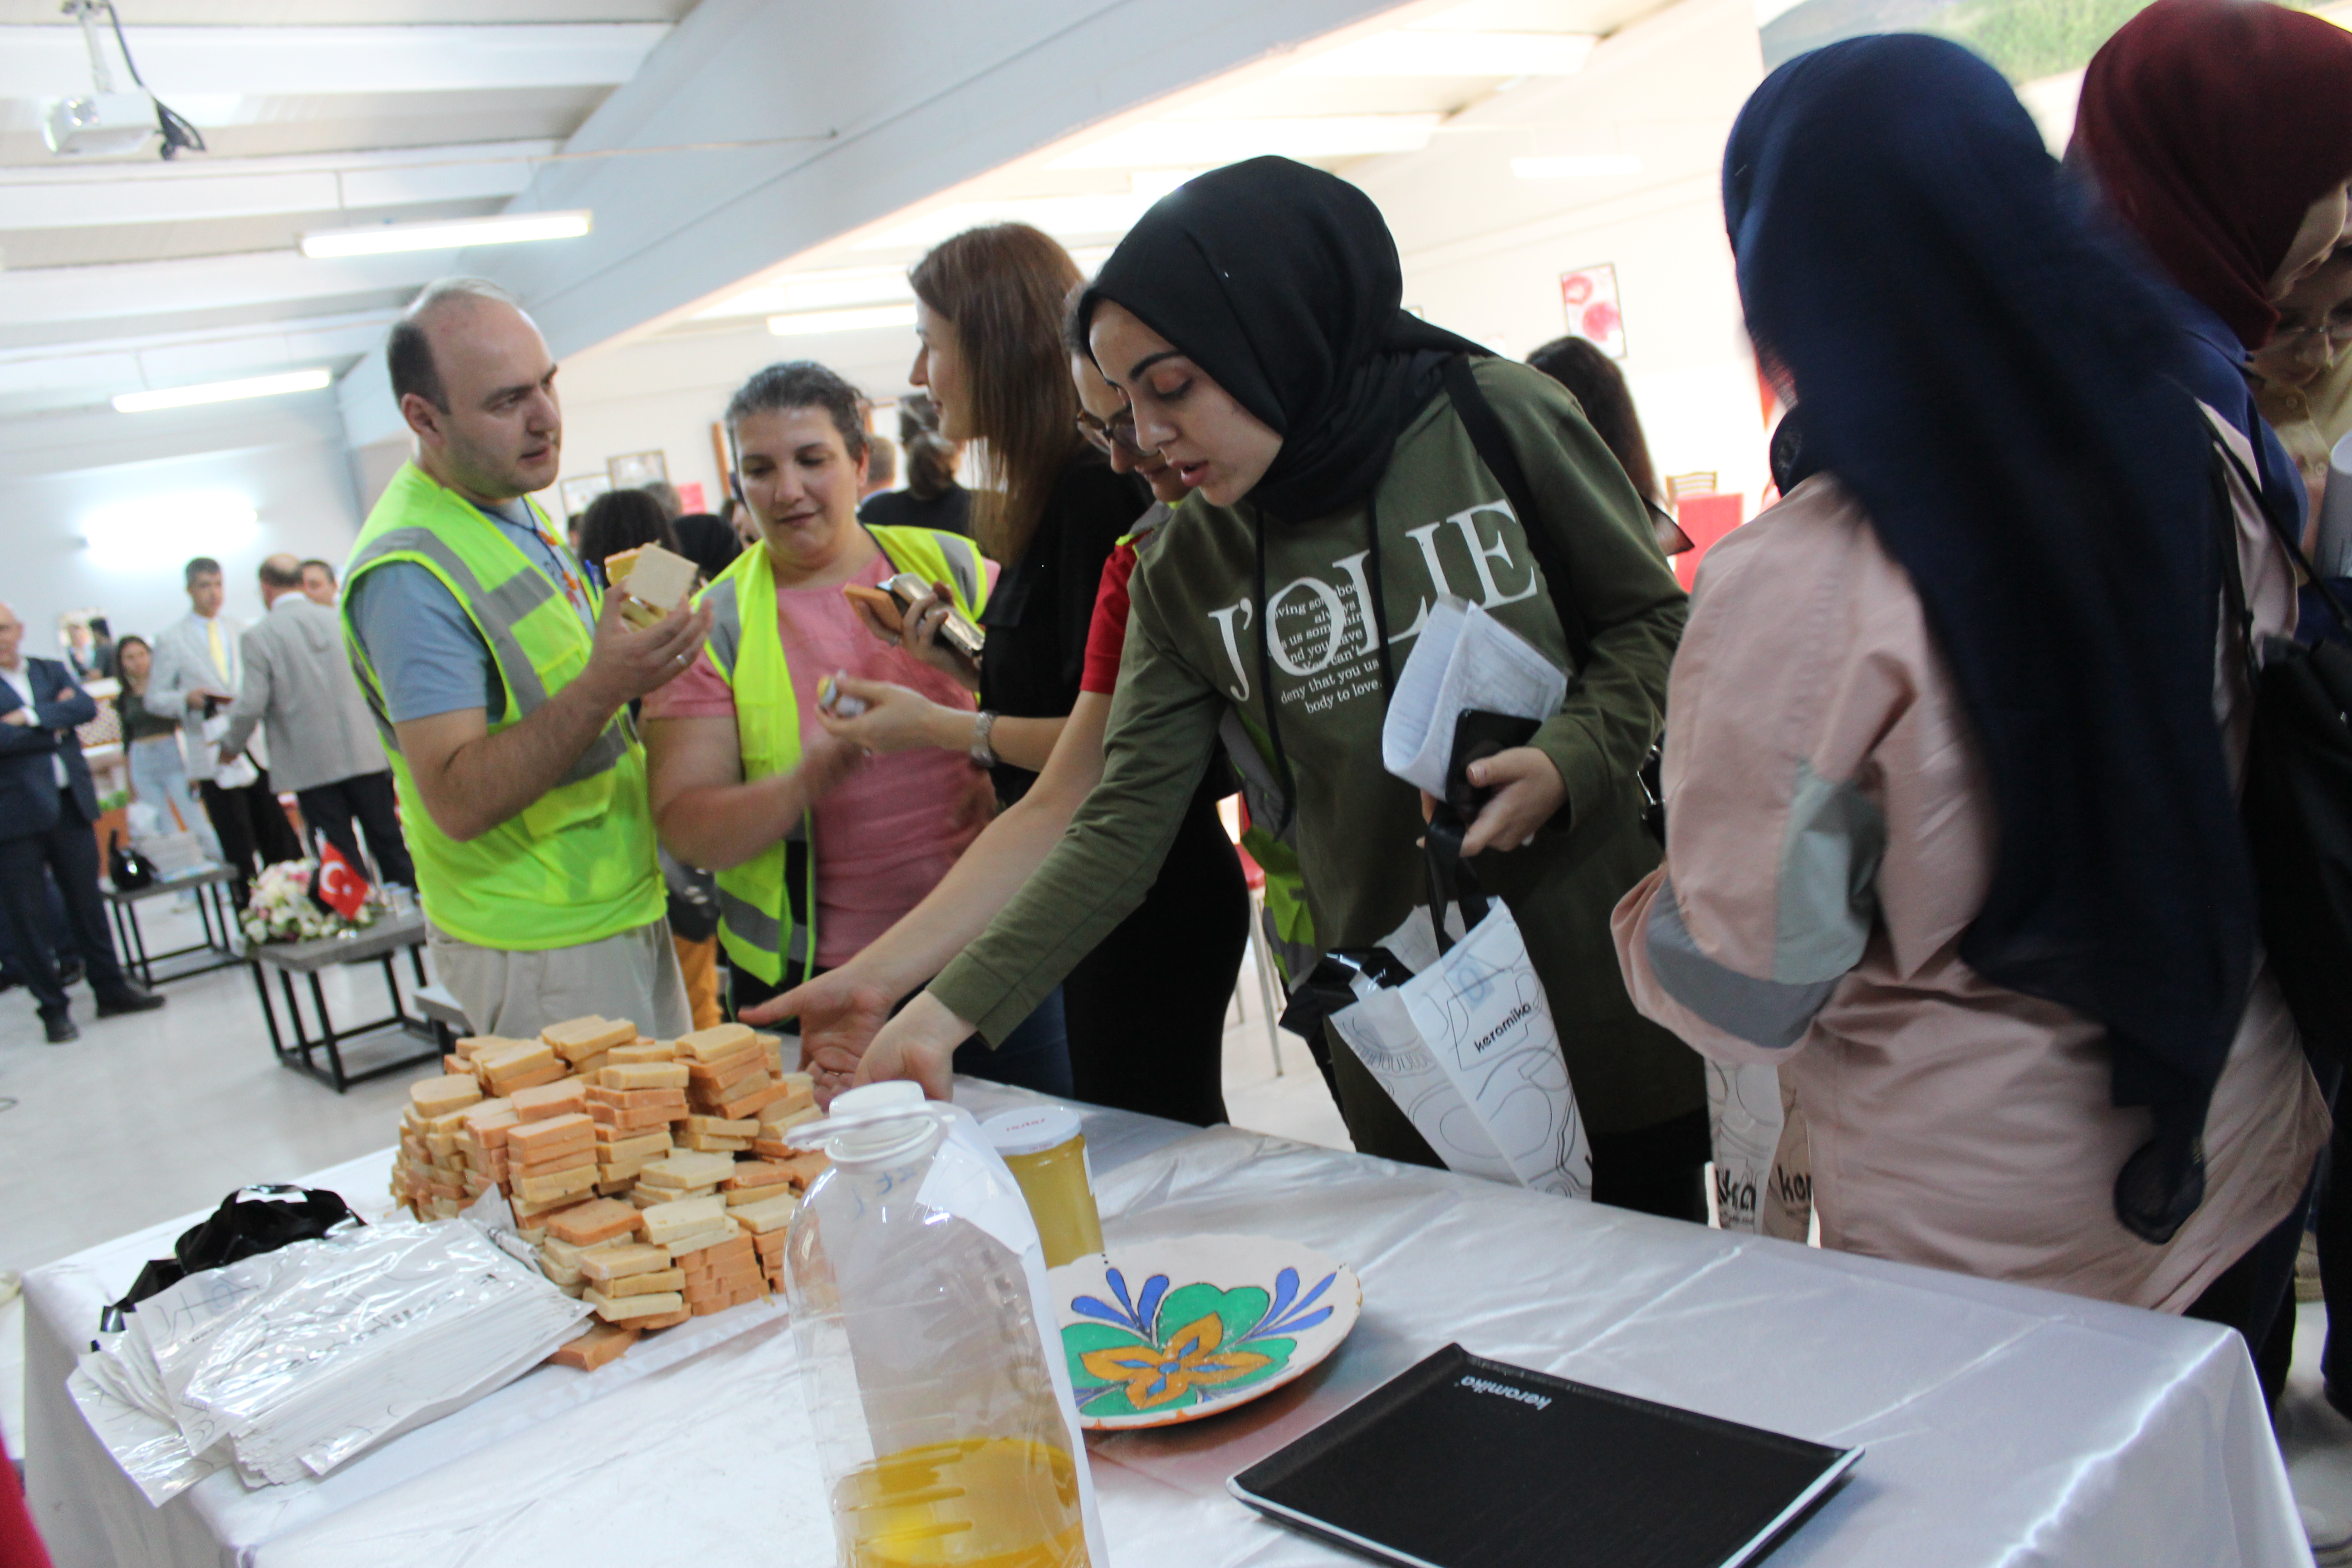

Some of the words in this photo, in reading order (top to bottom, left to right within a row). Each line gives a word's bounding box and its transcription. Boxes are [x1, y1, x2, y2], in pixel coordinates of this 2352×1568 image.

[1289, 631, 1303, 646] us
[1280, 686, 1306, 704] deny
[1308, 673, 1336, 693] that
[1337, 665, 1361, 686] you
[1304, 694, 1334, 714] body
[1337, 689, 1350, 702] to
